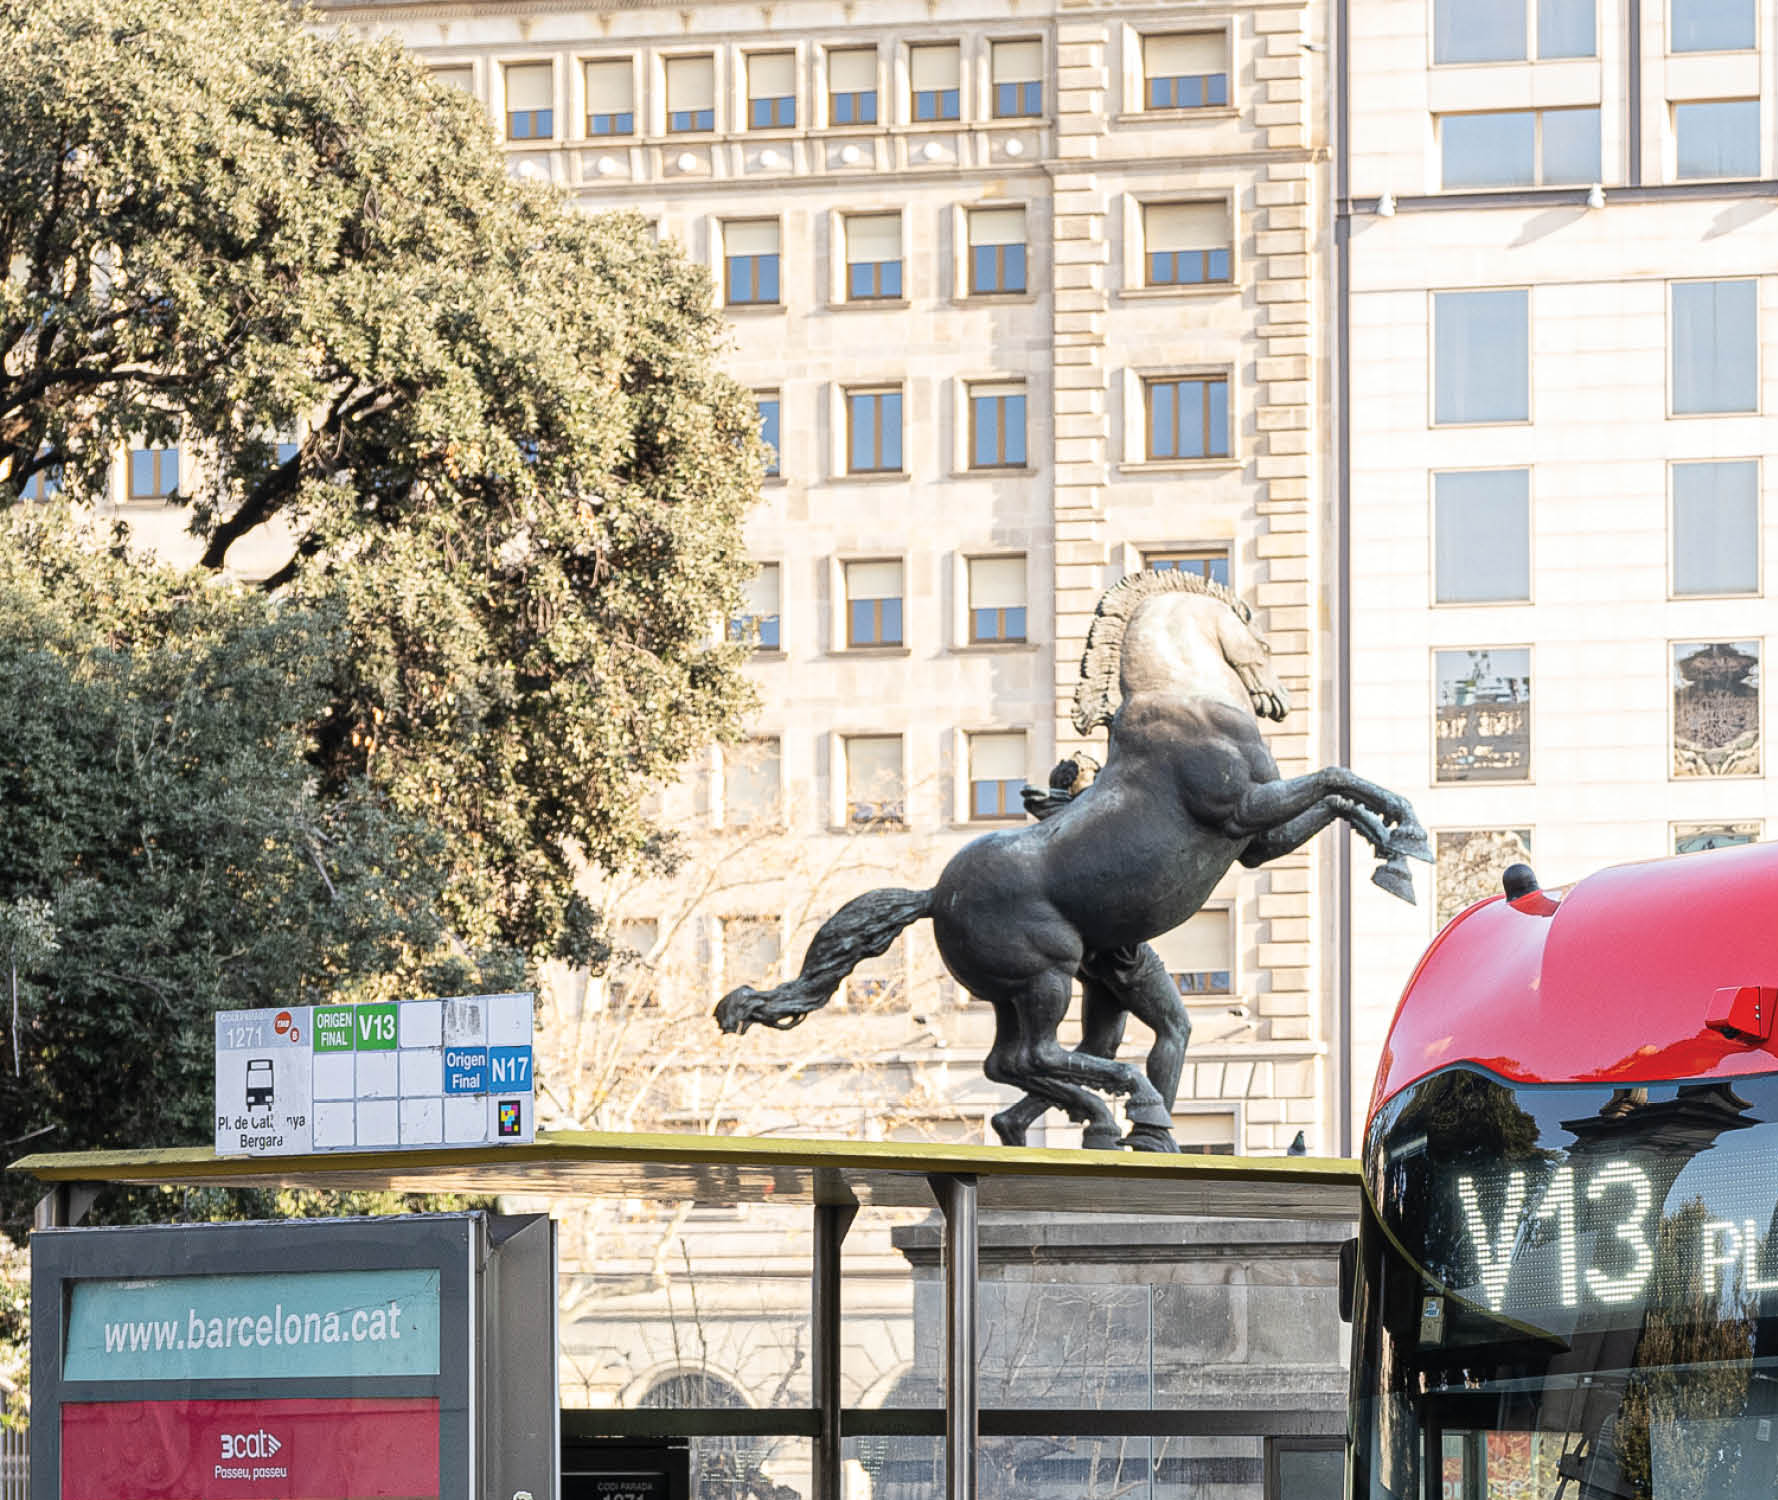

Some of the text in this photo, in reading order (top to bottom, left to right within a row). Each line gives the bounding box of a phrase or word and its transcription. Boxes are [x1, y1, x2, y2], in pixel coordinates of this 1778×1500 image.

[317, 1012, 352, 1029] ORIGEN
[359, 1014, 395, 1041] V13
[227, 1027, 263, 1048] 1271
[321, 1032, 348, 1046] FINAL
[447, 1052, 485, 1070] Origen
[492, 1057, 529, 1082] N17
[452, 1073, 480, 1088] Final
[218, 1116, 231, 1130] Pl.
[234, 1115, 248, 1130] de
[240, 1134, 283, 1150] Bergara
[1459, 1161, 1653, 1311] V13
[104, 1302, 401, 1352] www.barcelona.cat
[220, 1429, 269, 1459] 3cat
[214, 1465, 287, 1480] Passeu, passeu
